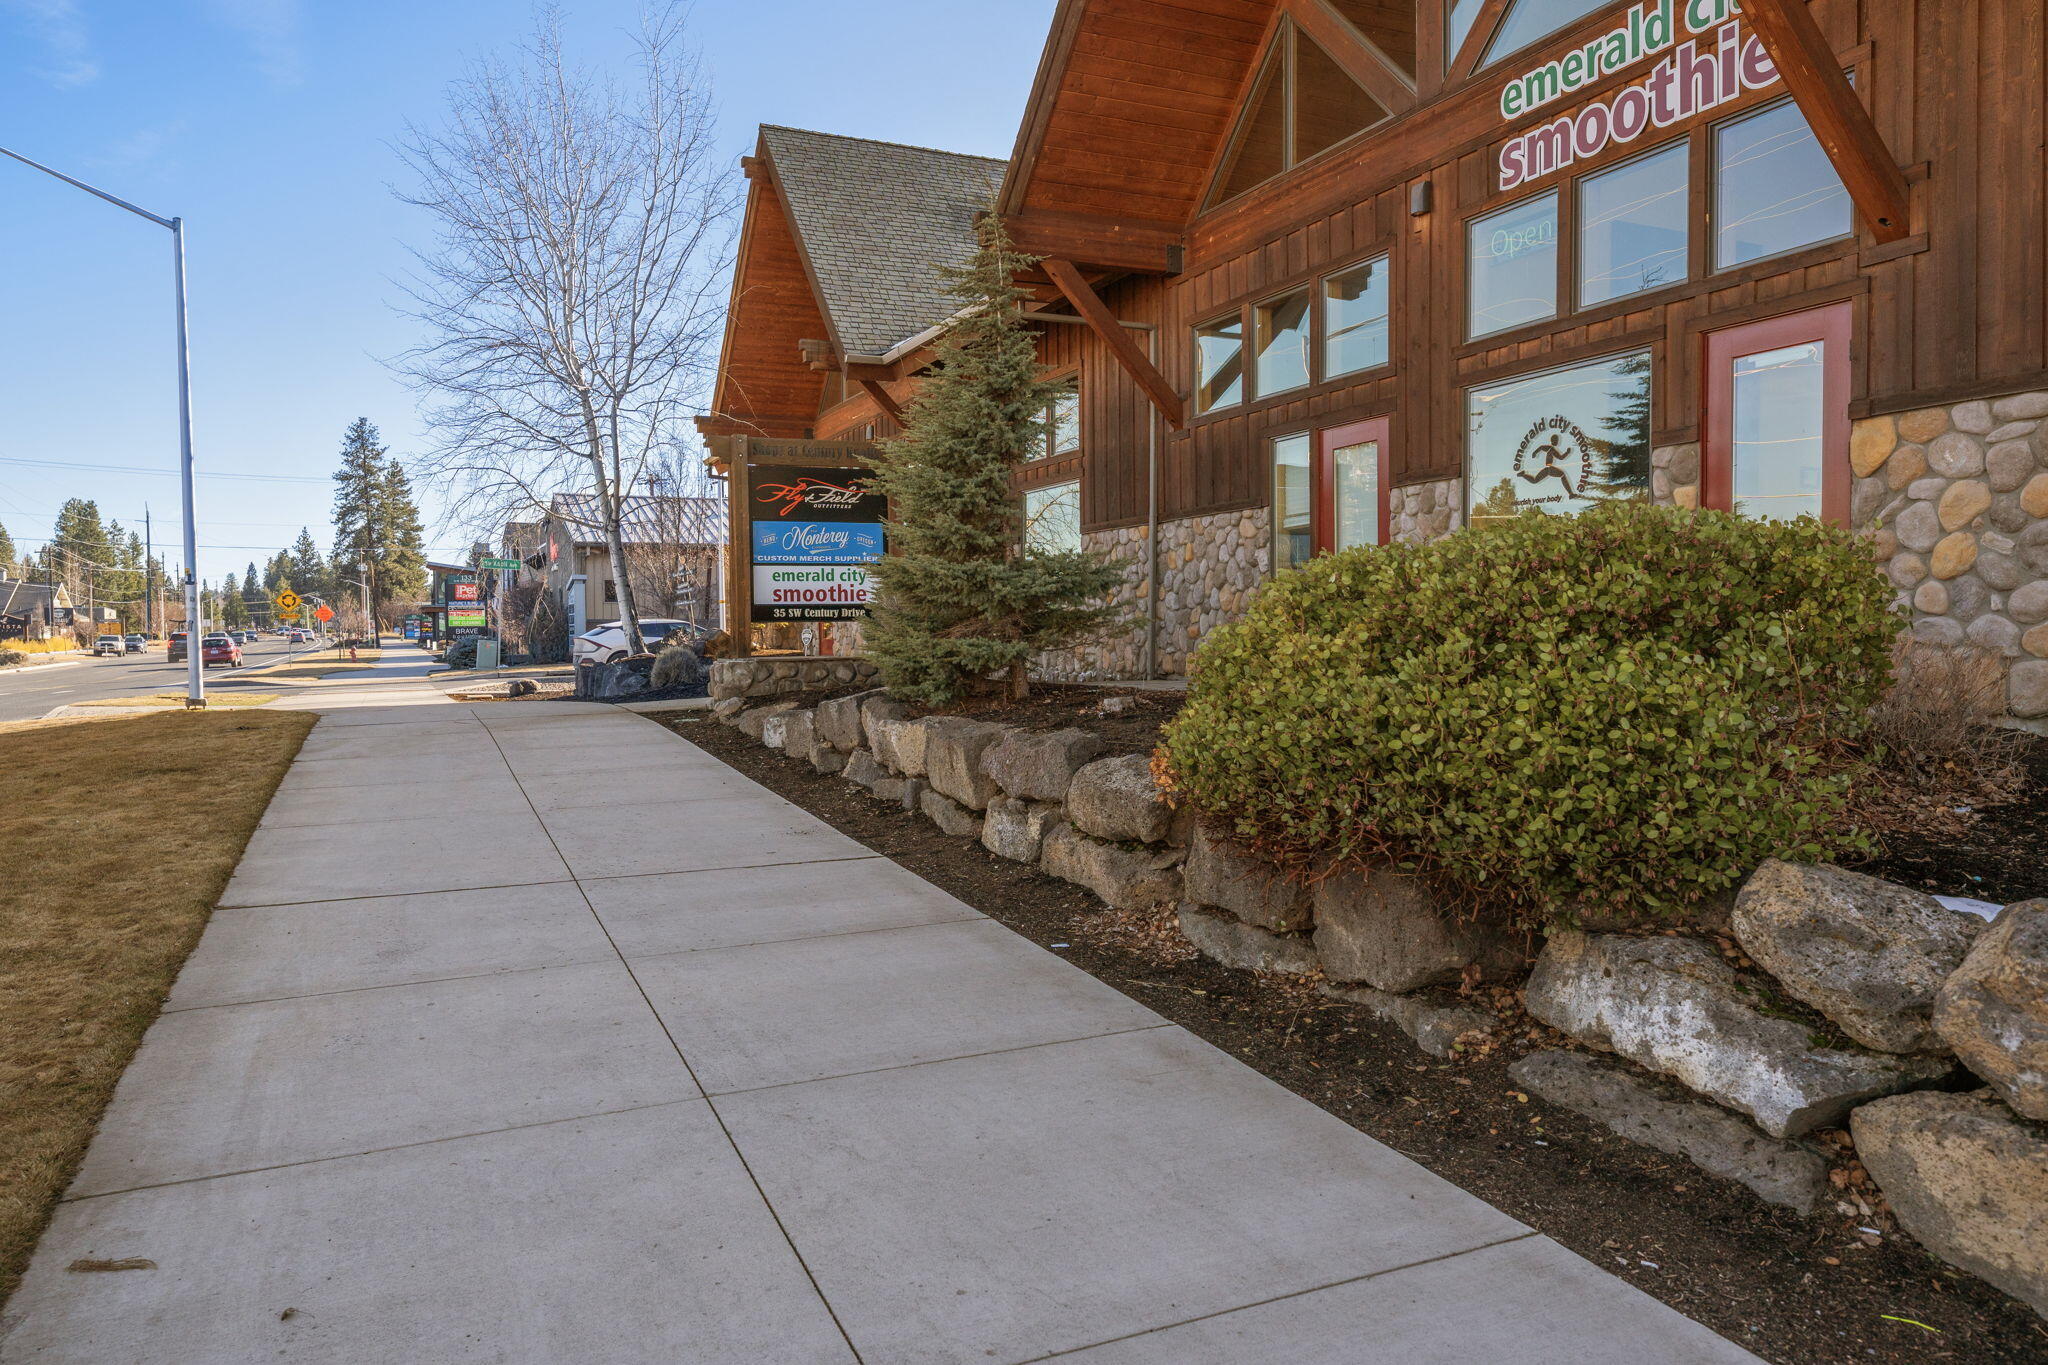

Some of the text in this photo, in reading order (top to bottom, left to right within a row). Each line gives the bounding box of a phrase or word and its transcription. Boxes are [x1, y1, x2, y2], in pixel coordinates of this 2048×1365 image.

[1501, 0, 1675, 119] emerald
[1500, 19, 1780, 190] smoothie
[1491, 219, 1552, 258] Open
[1513, 414, 1592, 493] emerald city smoothie
[756, 482, 807, 516] Fly
[806, 485, 865, 503] Field
[1531, 496, 1546, 505] your
[1547, 494, 1562, 503] body
[782, 524, 849, 551] Monterey
[834, 555, 879, 563] SUPPLIER
[771, 568, 866, 585] emerald city
[460, 585, 478, 595] Pet
[772, 584, 867, 602] smoothie
[773, 609, 866, 620] 35 SW Century Drive
